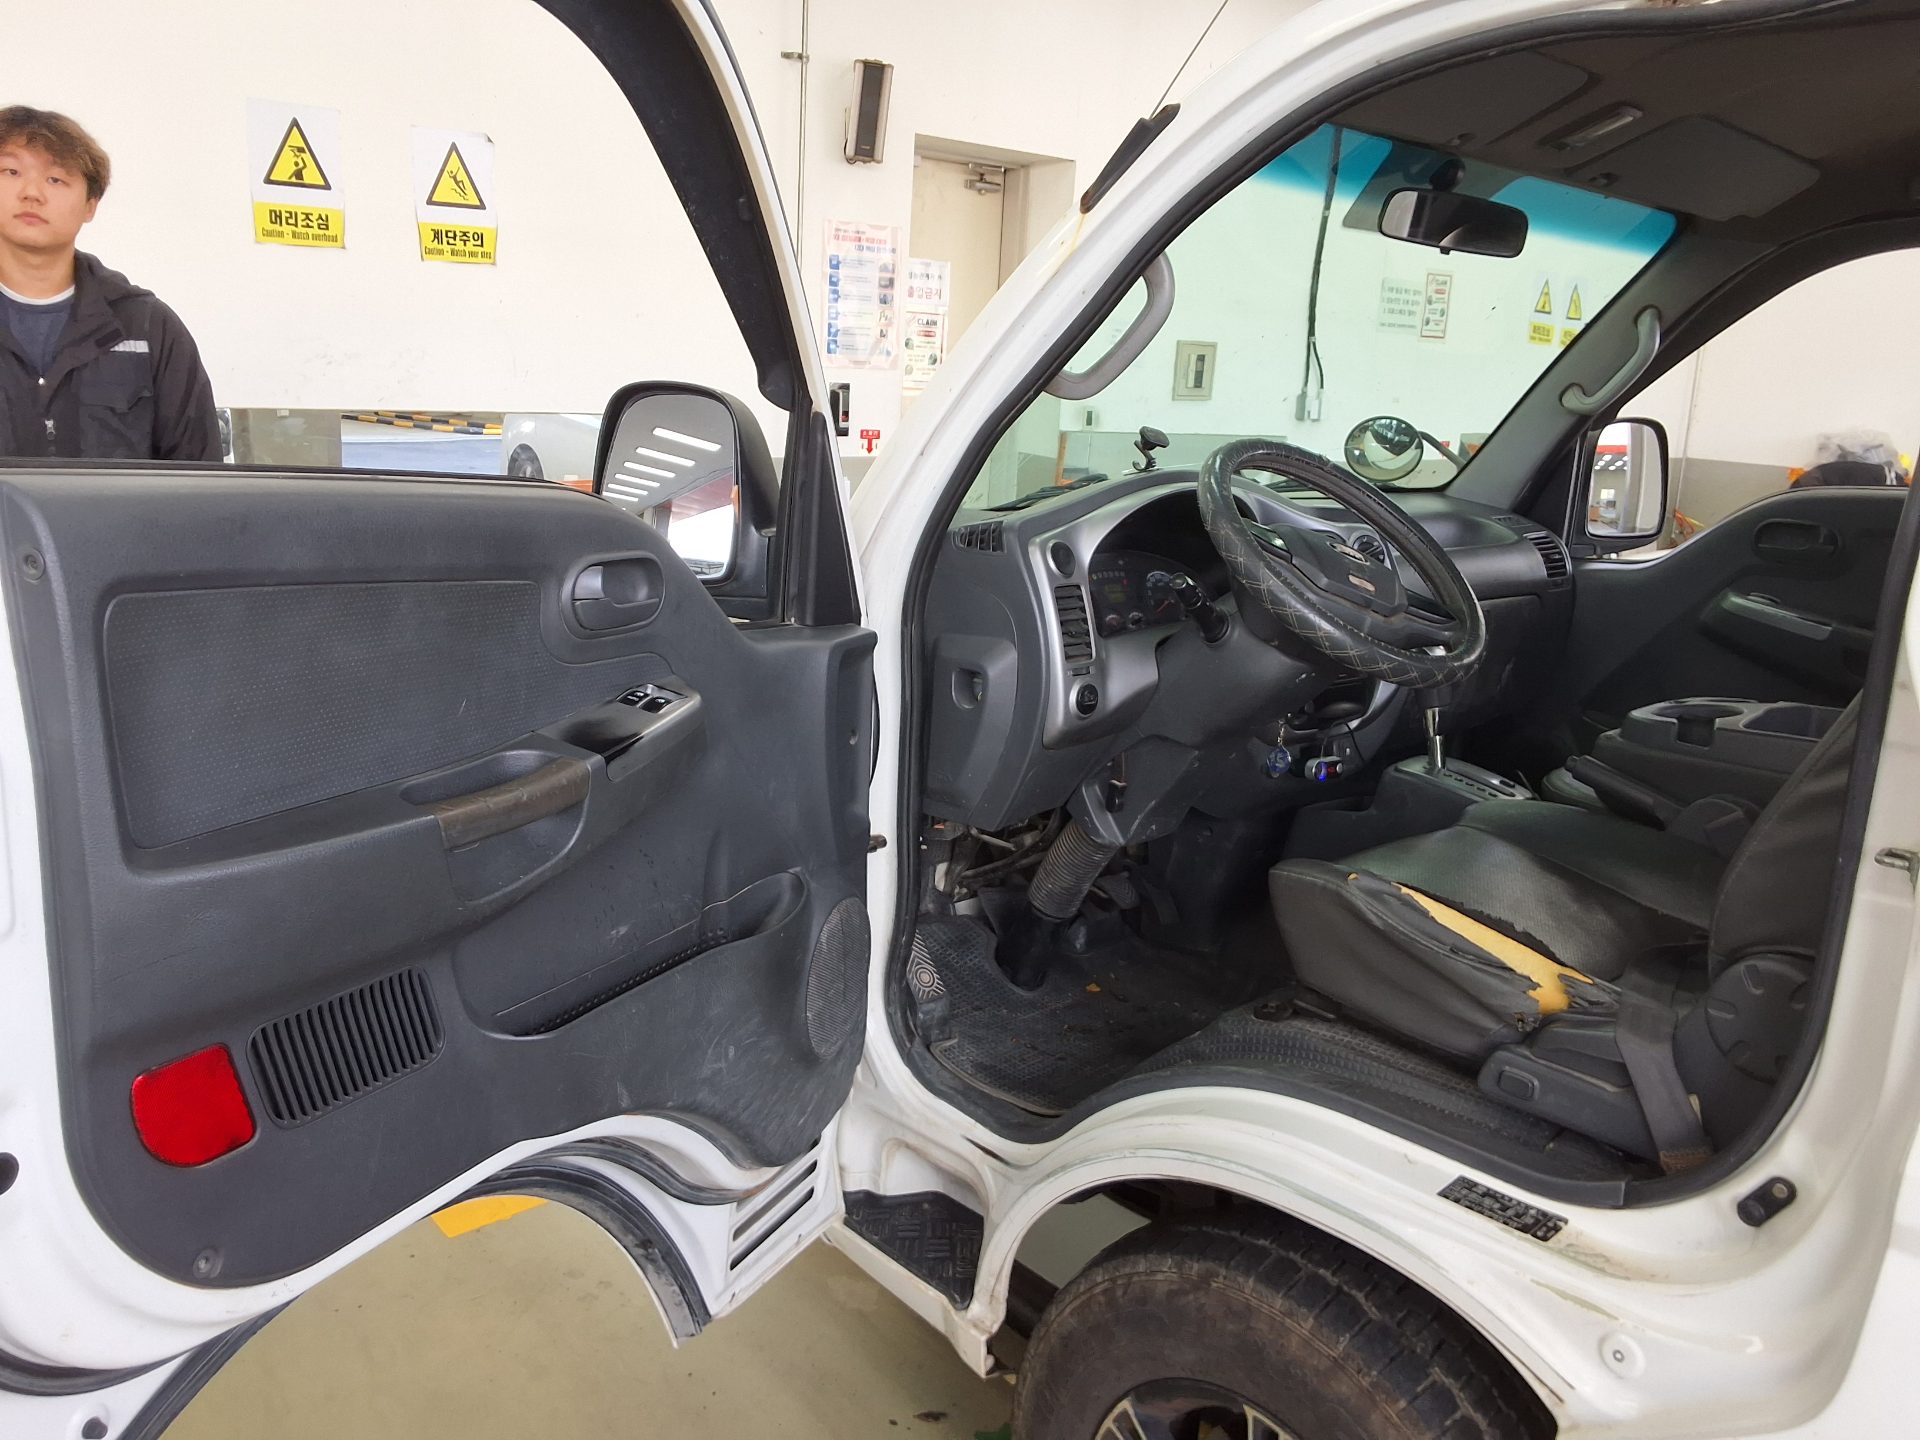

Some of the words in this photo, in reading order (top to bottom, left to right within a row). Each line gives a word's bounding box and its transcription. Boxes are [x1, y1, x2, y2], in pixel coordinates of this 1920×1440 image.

[268, 208, 330, 231] 머리조심
[261, 227, 285, 239] Caution
[291, 230, 310, 241] Watch
[311, 232, 339, 243] overhead
[430, 228, 484, 248] 계단주의
[424, 245, 445, 256] Caution
[450, 247, 467, 258] Watch
[468, 249, 480, 259] your
[907, 286, 942, 301] 출입금지
